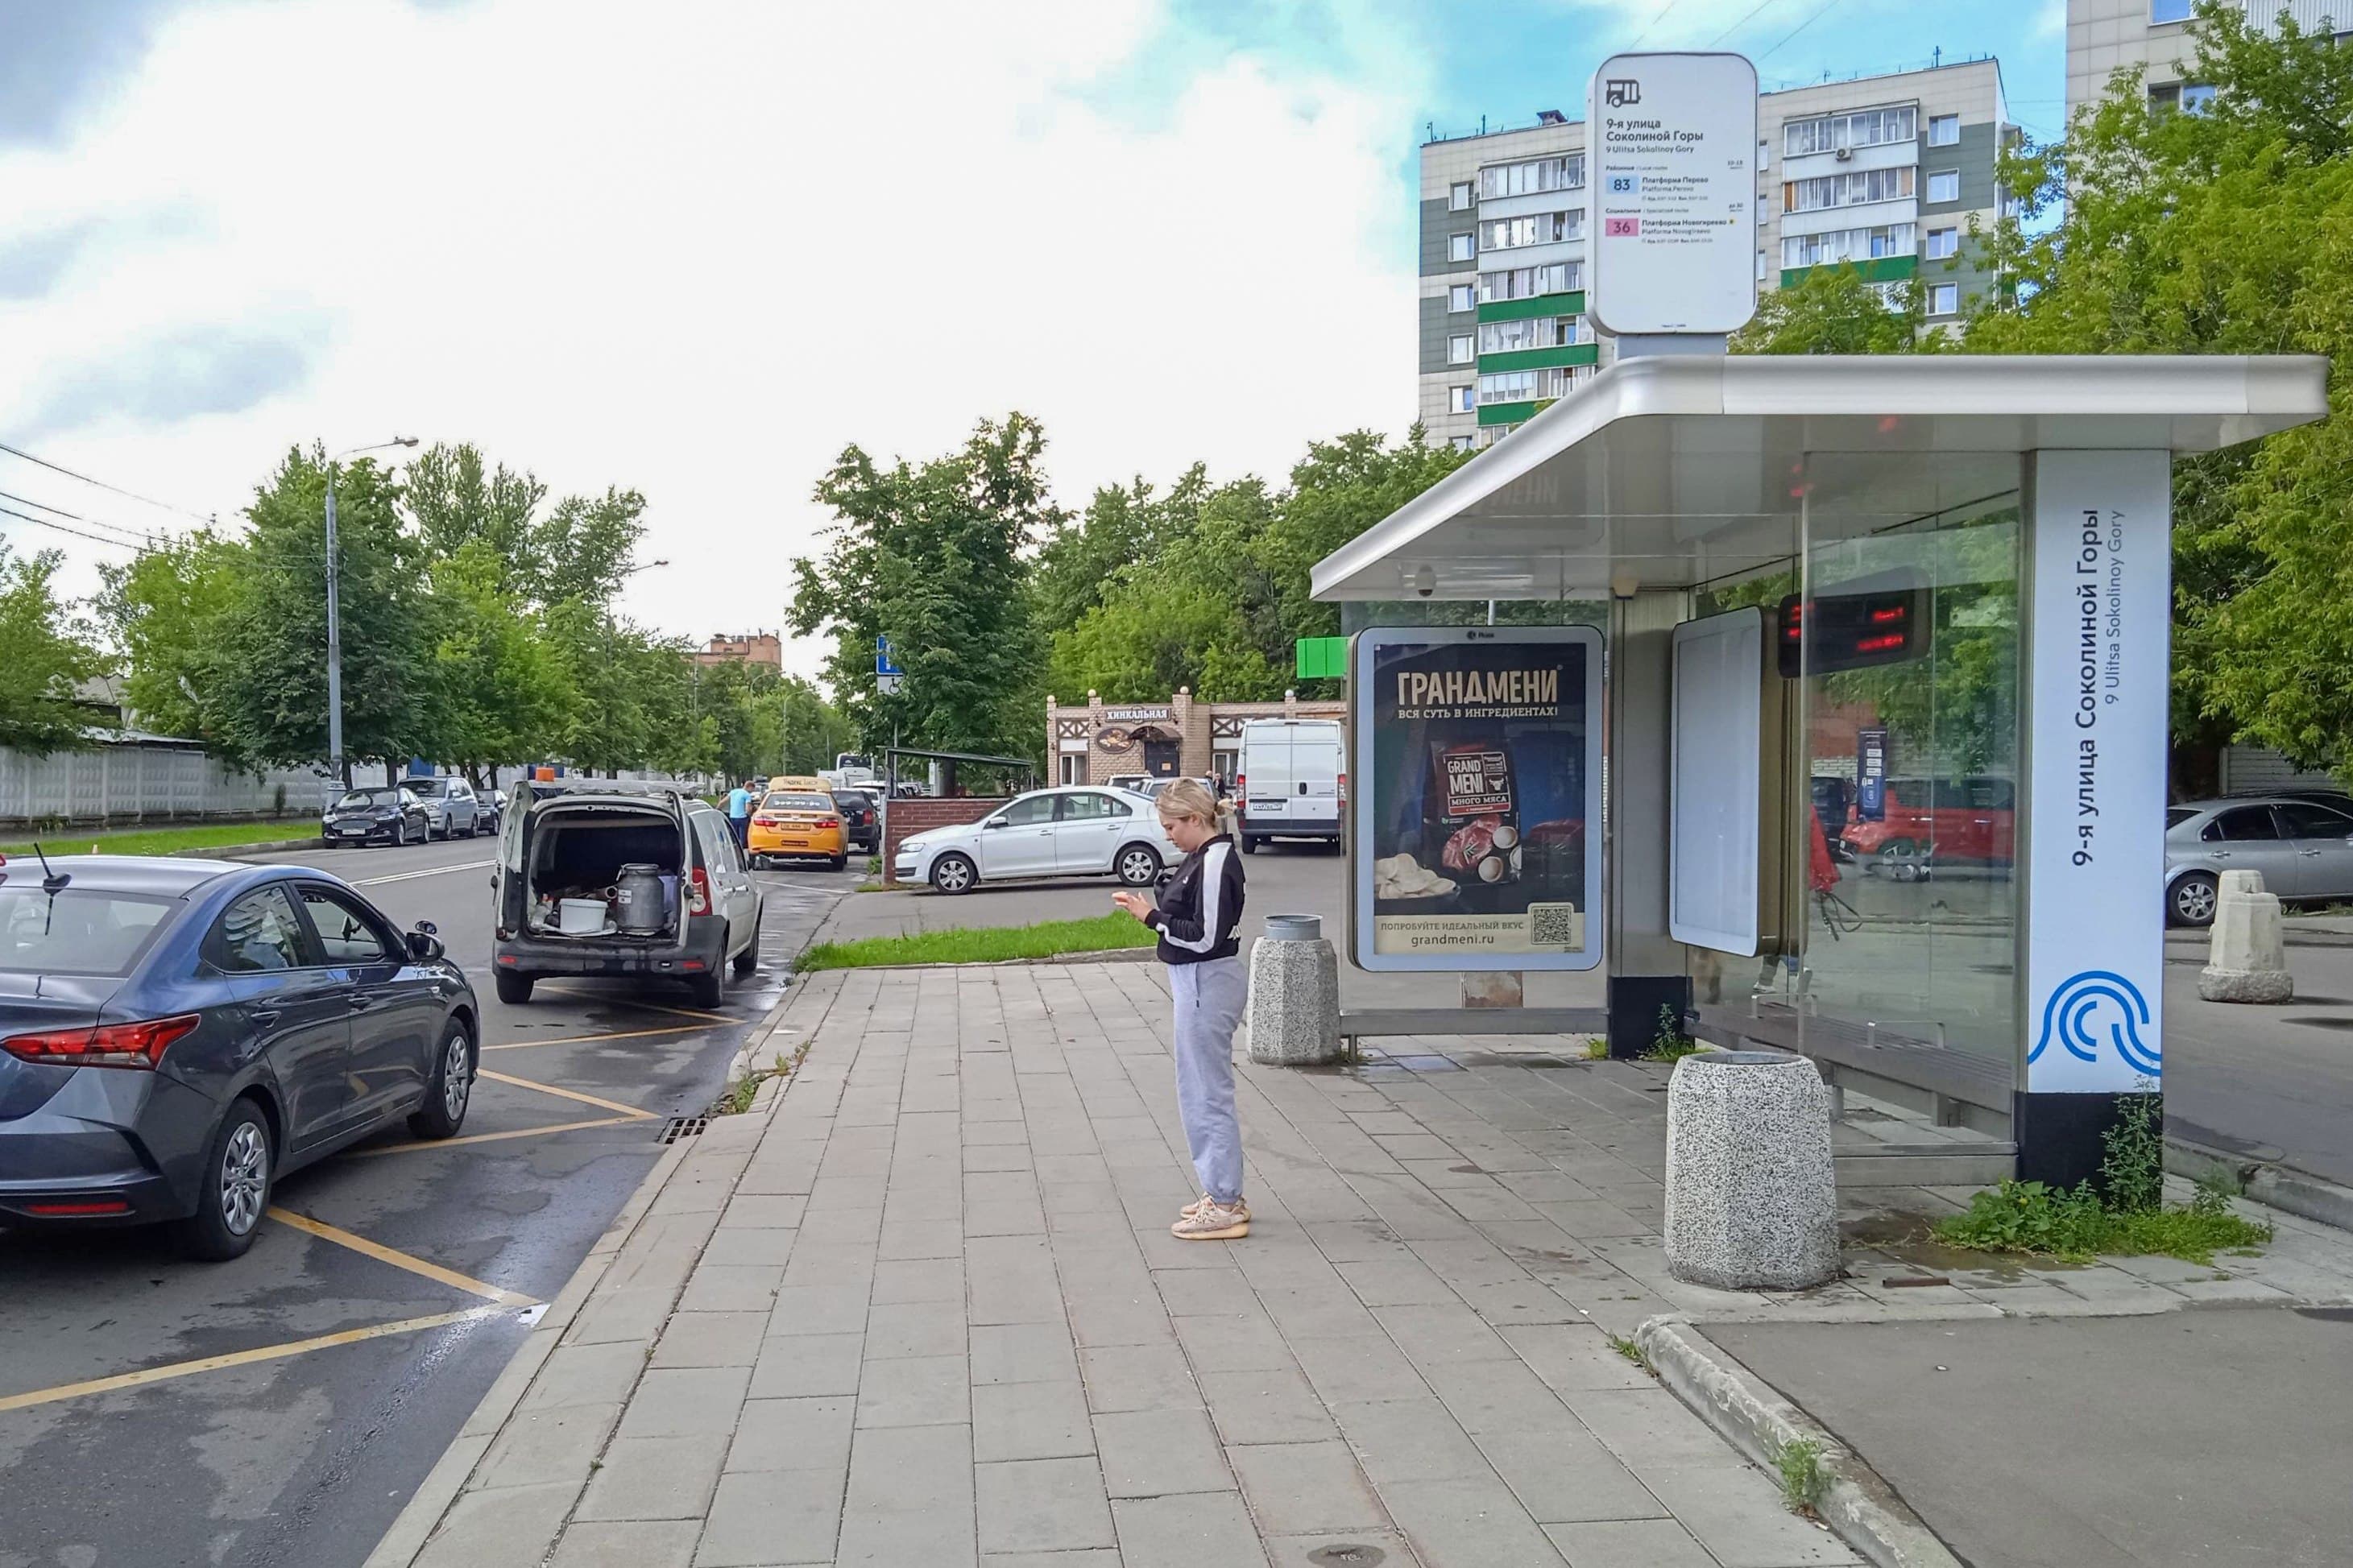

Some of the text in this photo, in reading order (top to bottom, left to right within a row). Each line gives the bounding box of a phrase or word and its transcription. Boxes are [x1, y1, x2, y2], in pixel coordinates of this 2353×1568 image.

[1606, 118, 1661, 130] 9-я улица
[1606, 130, 1704, 143] Соколиной Горы
[1637, 146, 1674, 154] Sokolinoy
[1676, 145, 1694, 154] Gory
[1614, 179, 1630, 191] 83
[1642, 176, 1709, 185] Платформа Перово
[1614, 221, 1630, 234] 36
[2105, 510, 2125, 704] 9 Ulitsa Sokolinoy Gory
[1398, 669, 1558, 705] ГРАНДМЕНИ
[2073, 510, 2102, 867] 9-я улица Соколиной Горы
[1107, 710, 1167, 720] ХИНКАЛЬНАЯ
[1398, 706, 1558, 719] ВСЯ СУТЬ В ИНГРЕДИЕНТАХ!
[1448, 759, 1481, 773] GRAND
[1449, 773, 1484, 795] MENI
[1452, 796, 1507, 806] МНОГО МЯСА
[1381, 921, 1525, 931] ПОПРОБУЙТЕ ИДЕАЛЬНЫЙ ВКУС
[1411, 933, 1495, 947] grandmeni.ru
